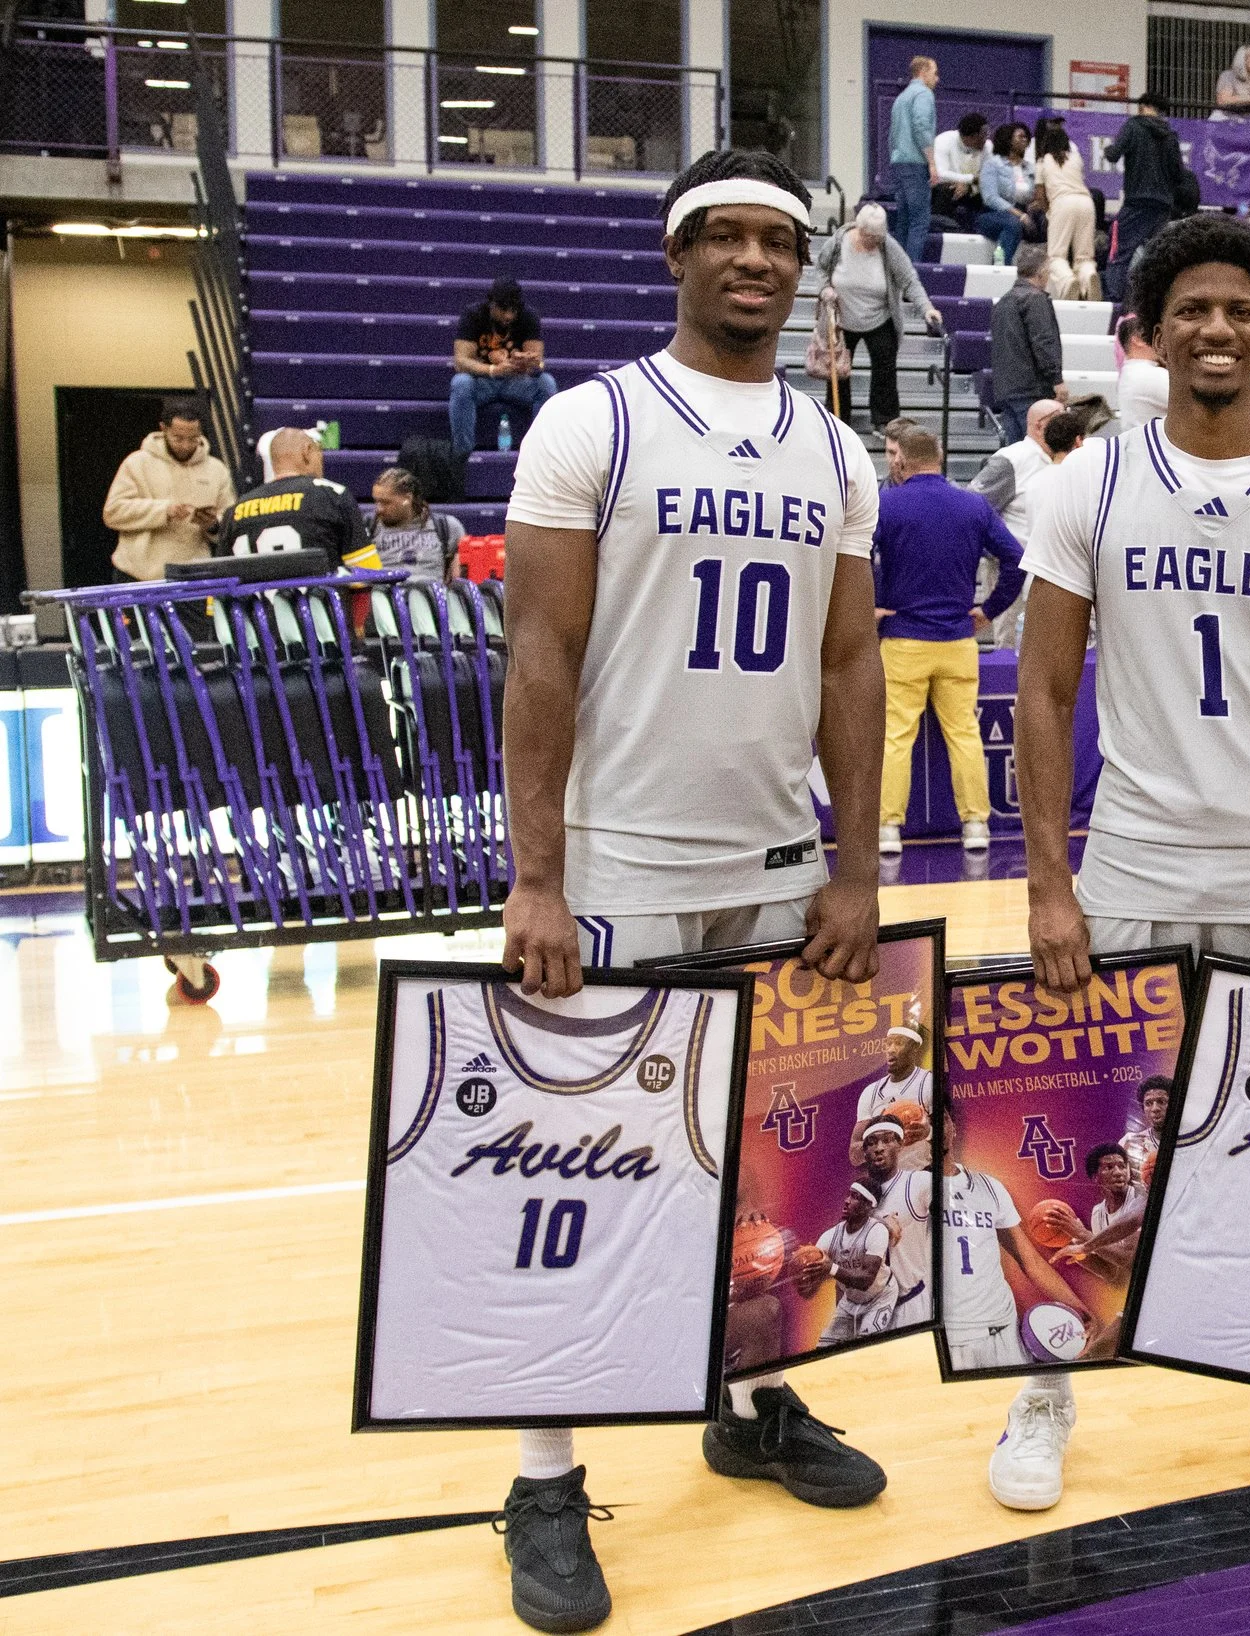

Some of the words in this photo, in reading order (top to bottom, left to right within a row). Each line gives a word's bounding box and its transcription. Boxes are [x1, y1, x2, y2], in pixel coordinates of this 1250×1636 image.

[234, 493, 304, 522] STEWART
[655, 487, 827, 548] EAGLES
[686, 557, 792, 674] 10
[1193, 613, 1229, 717] 1
[751, 992, 914, 1053] NEST
[779, 1045, 850, 1072] BASKETBALL
[860, 1039, 889, 1057] 2025
[944, 1017, 1181, 1073] WOTITE
[461, 1065, 498, 1074] adidas
[644, 1061, 671, 1081] DC
[646, 1080, 662, 1090] #12
[952, 1083, 985, 1099] AVILA
[987, 1077, 1024, 1096] MEN'S
[1026, 1070, 1101, 1092] BASKETBALL
[1111, 1065, 1143, 1083] 2025
[462, 1084, 490, 1104] JB
[467, 1104, 484, 1113] #21
[760, 1081, 819, 1153] AU
[450, 1120, 661, 1182] Avila
[1016, 1113, 1077, 1182] AU
[514, 1198, 588, 1270] 10
[943, 1210, 993, 1229] AGES
[957, 1235, 974, 1275] 1
